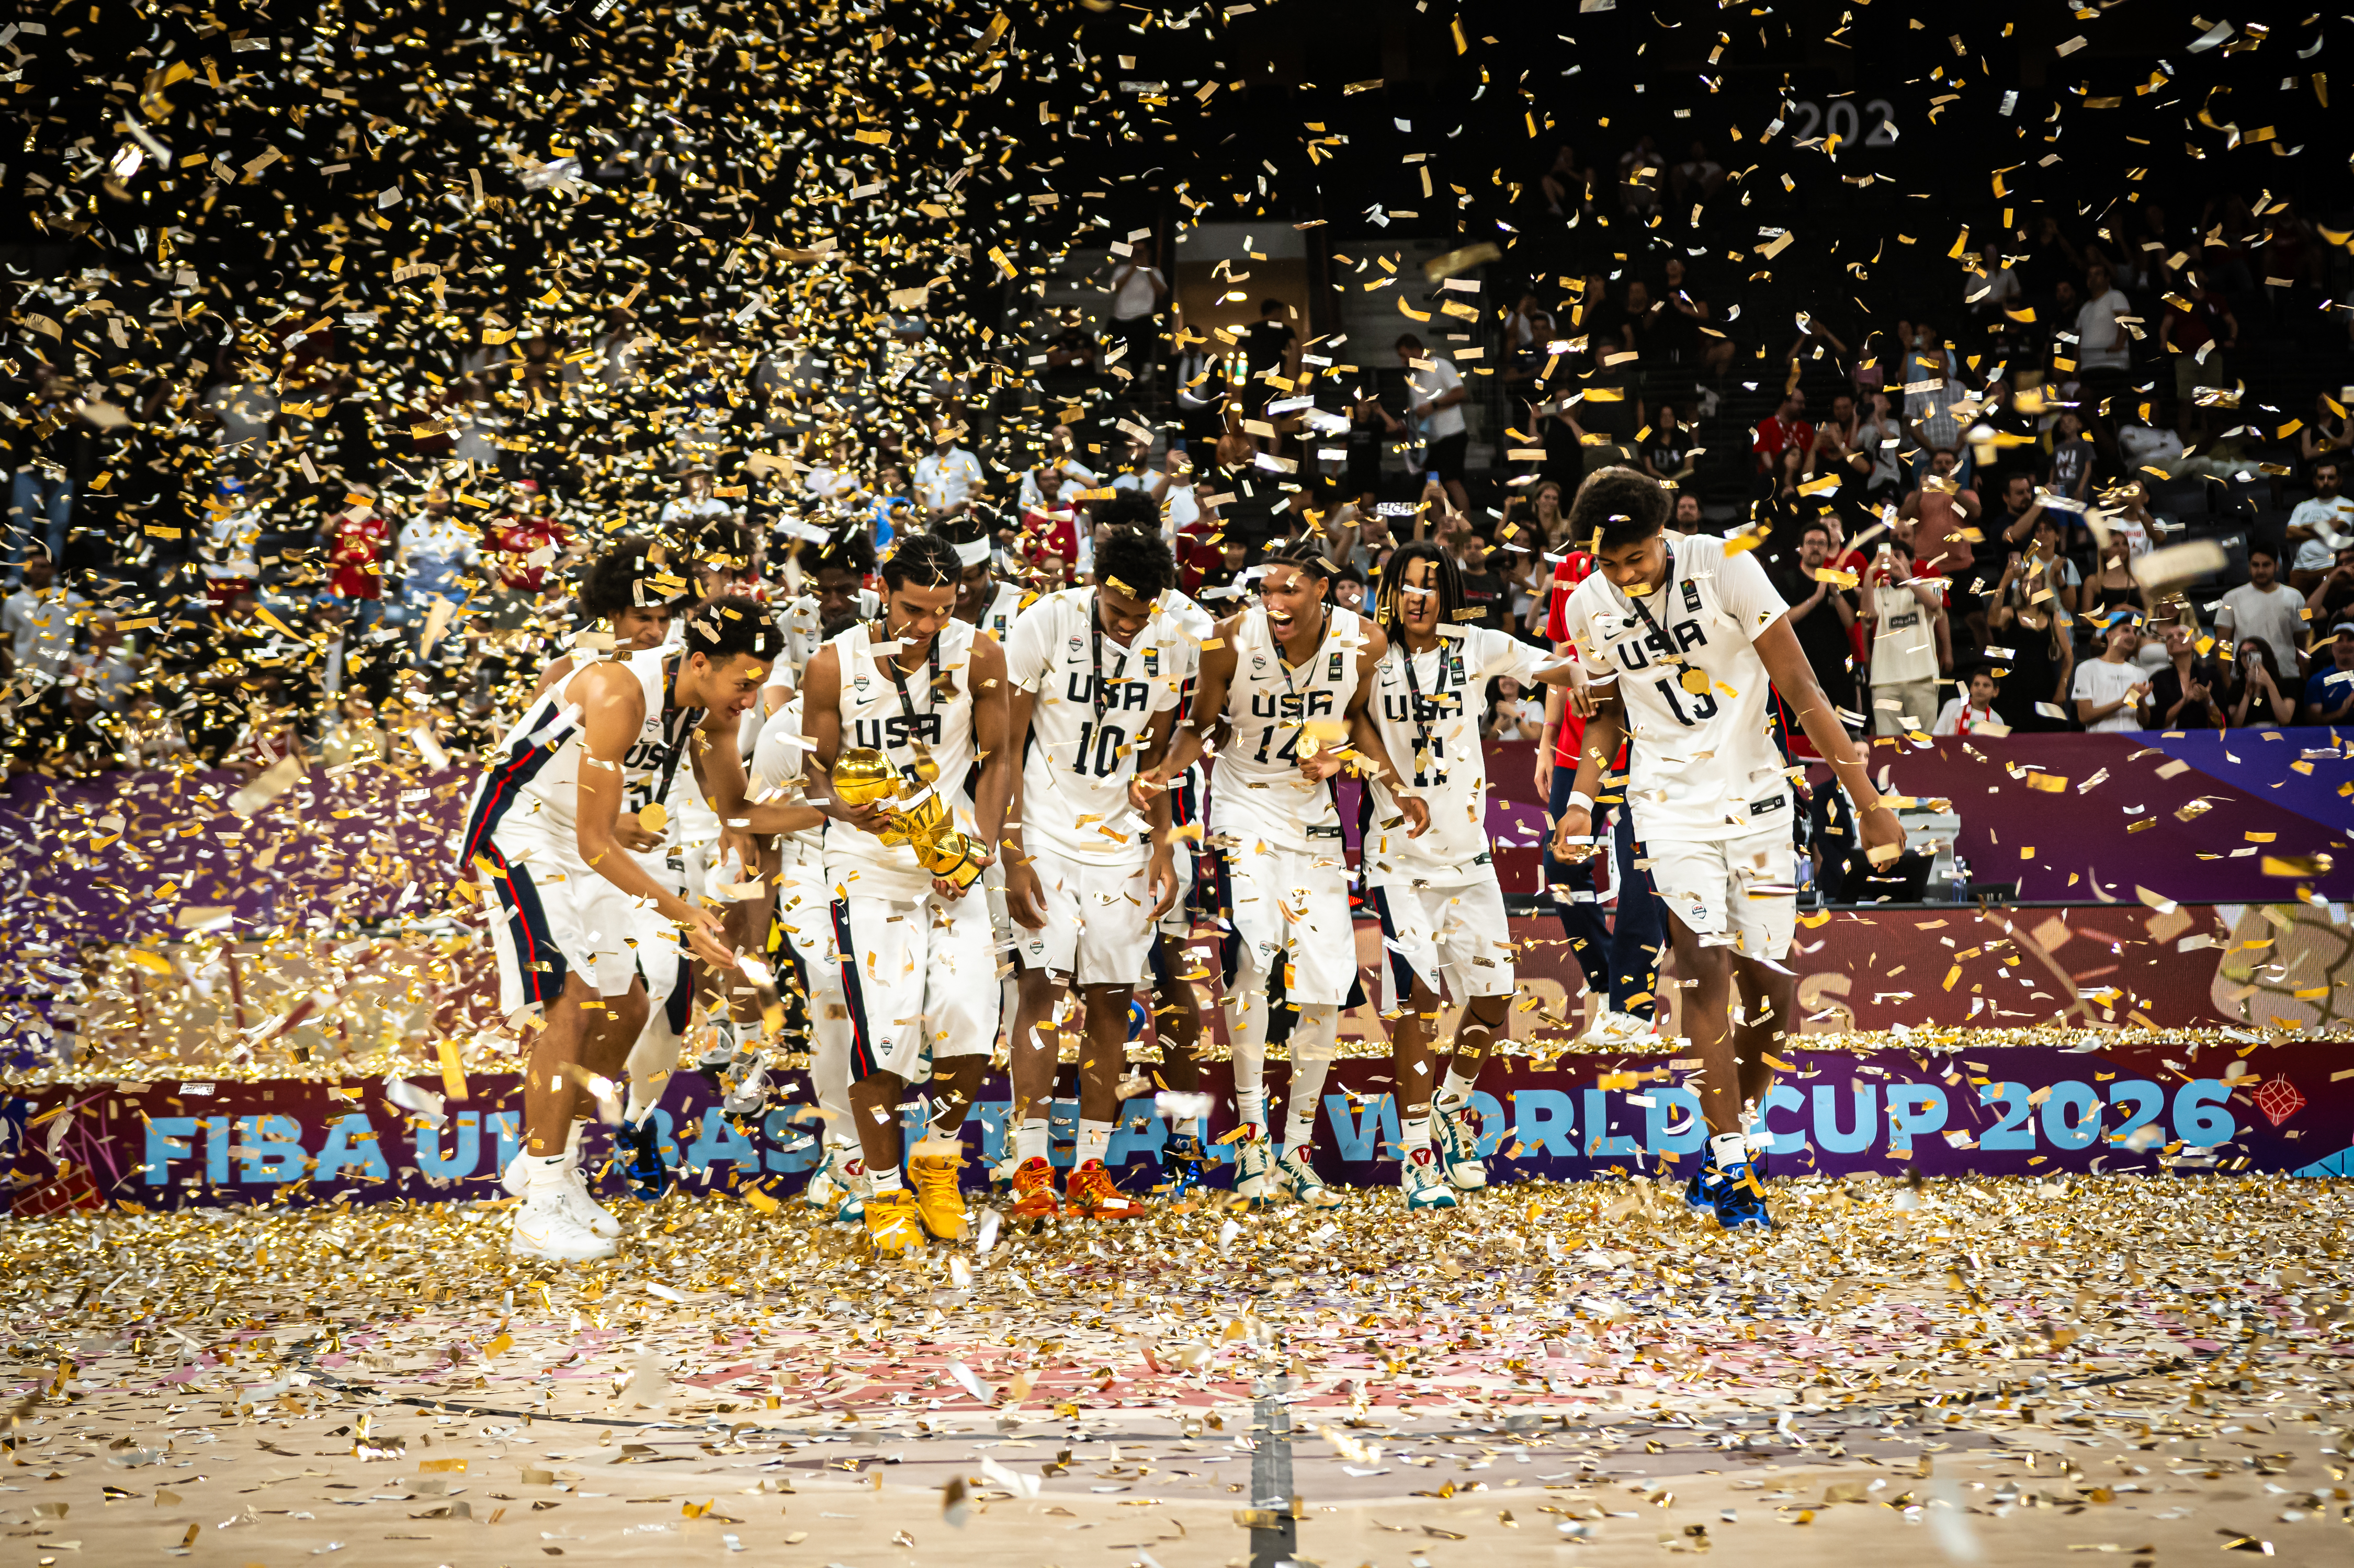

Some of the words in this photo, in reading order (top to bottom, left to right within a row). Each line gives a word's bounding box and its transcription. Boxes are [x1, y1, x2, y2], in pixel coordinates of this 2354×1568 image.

[1793, 99, 1896, 149] 202
[1252, 690, 1333, 718] USA
[856, 713, 942, 751] USA
[1072, 722, 1126, 778] 10
[1254, 725, 1300, 767] 14
[624, 744, 664, 770] US
[1411, 736, 1448, 787] 11
[913, 798, 935, 829] 17
[144, 1113, 390, 1185] FIBA
[416, 1110, 520, 1179] U1
[1746, 1083, 1949, 1154] CUP
[1979, 1078, 2237, 1151] 2026
